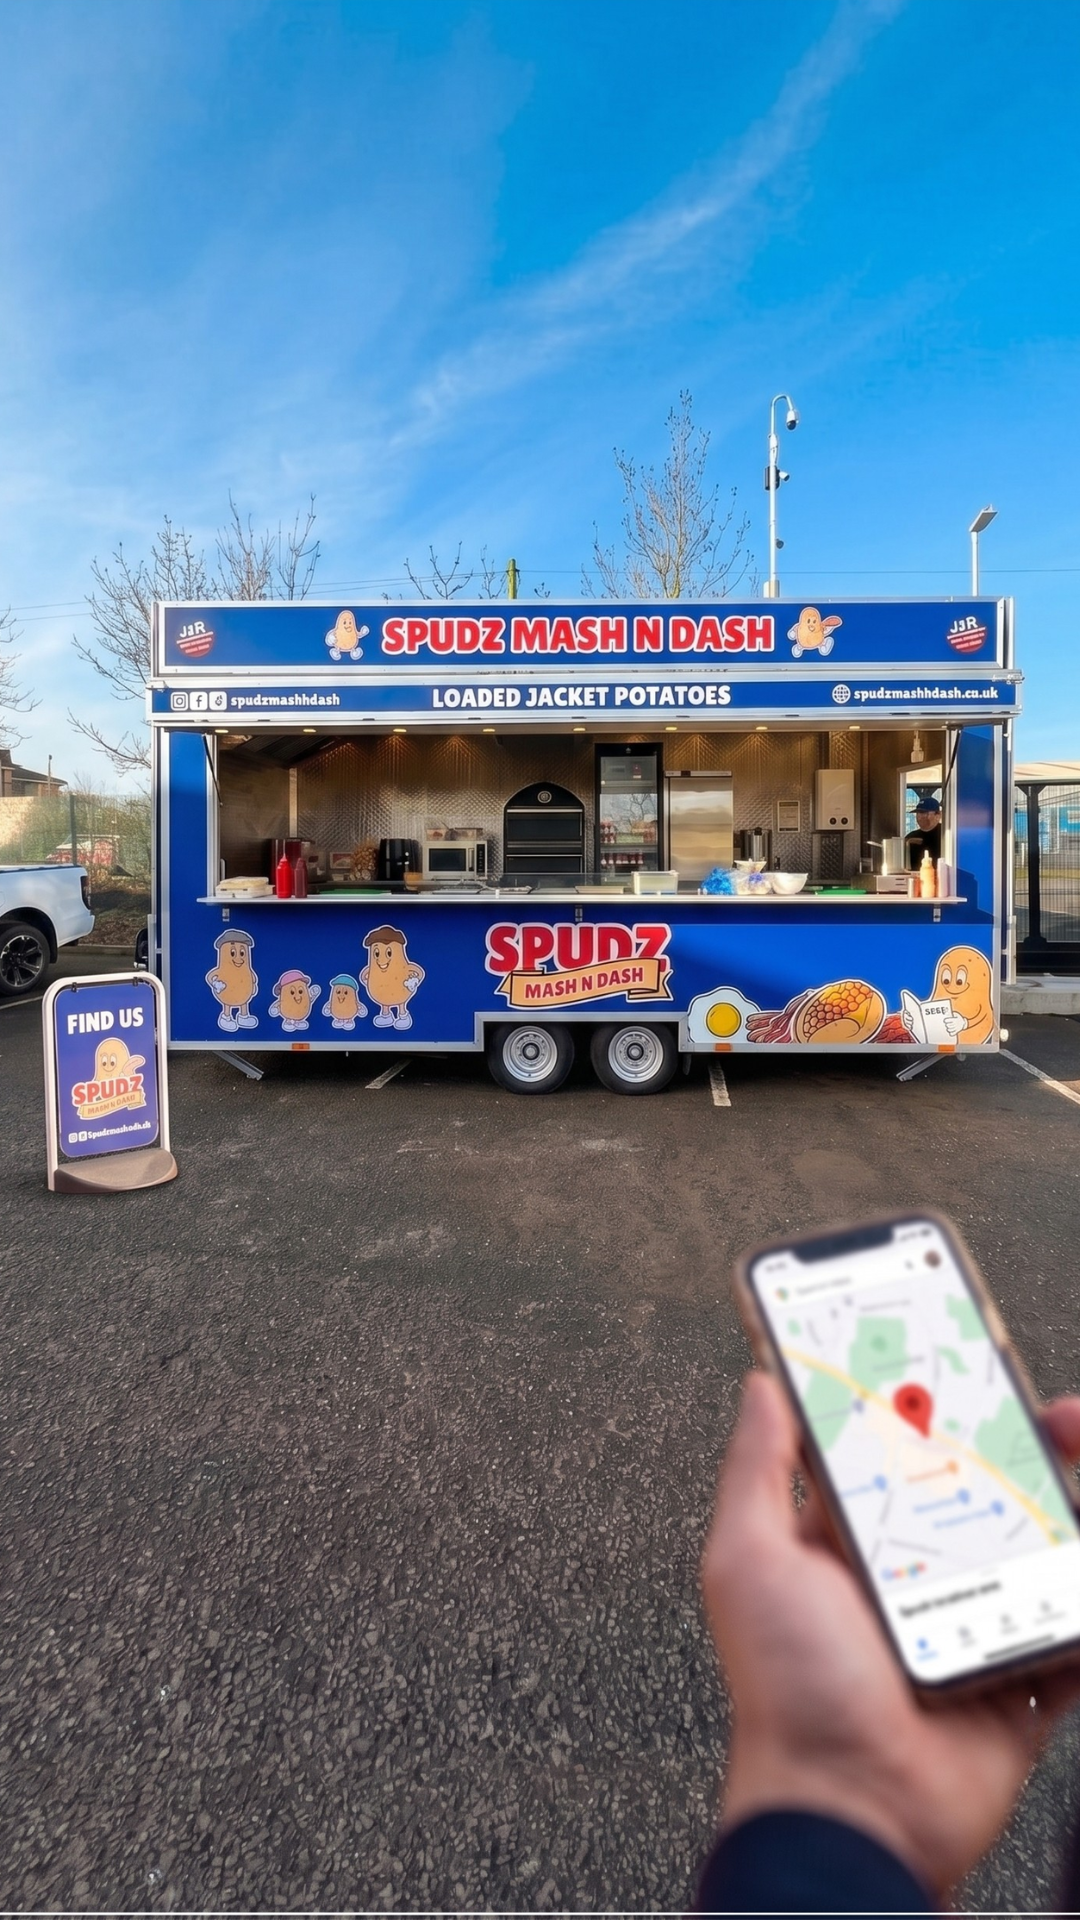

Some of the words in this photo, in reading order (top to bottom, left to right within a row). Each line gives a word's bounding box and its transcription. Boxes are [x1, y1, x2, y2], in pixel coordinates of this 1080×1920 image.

[382, 618, 505, 654] SPUDZ
[511, 616, 627, 653] MASH
[634, 616, 663, 653] N
[669, 615, 774, 653] DASH
[230, 693, 340, 709] spudzmashhdash
[432, 687, 523, 708] LOADED
[525, 686, 609, 707] JACKET
[614, 685, 731, 706] POTATOES
[485, 923, 671, 975] SPUDZ
[524, 979, 577, 999] MASH
[581, 979, 594, 992] N
[597, 967, 644, 988] DASH
[67, 1010, 114, 1034] FIND
[119, 1007, 144, 1028] US
[72, 1073, 143, 1106] SPUDZ
